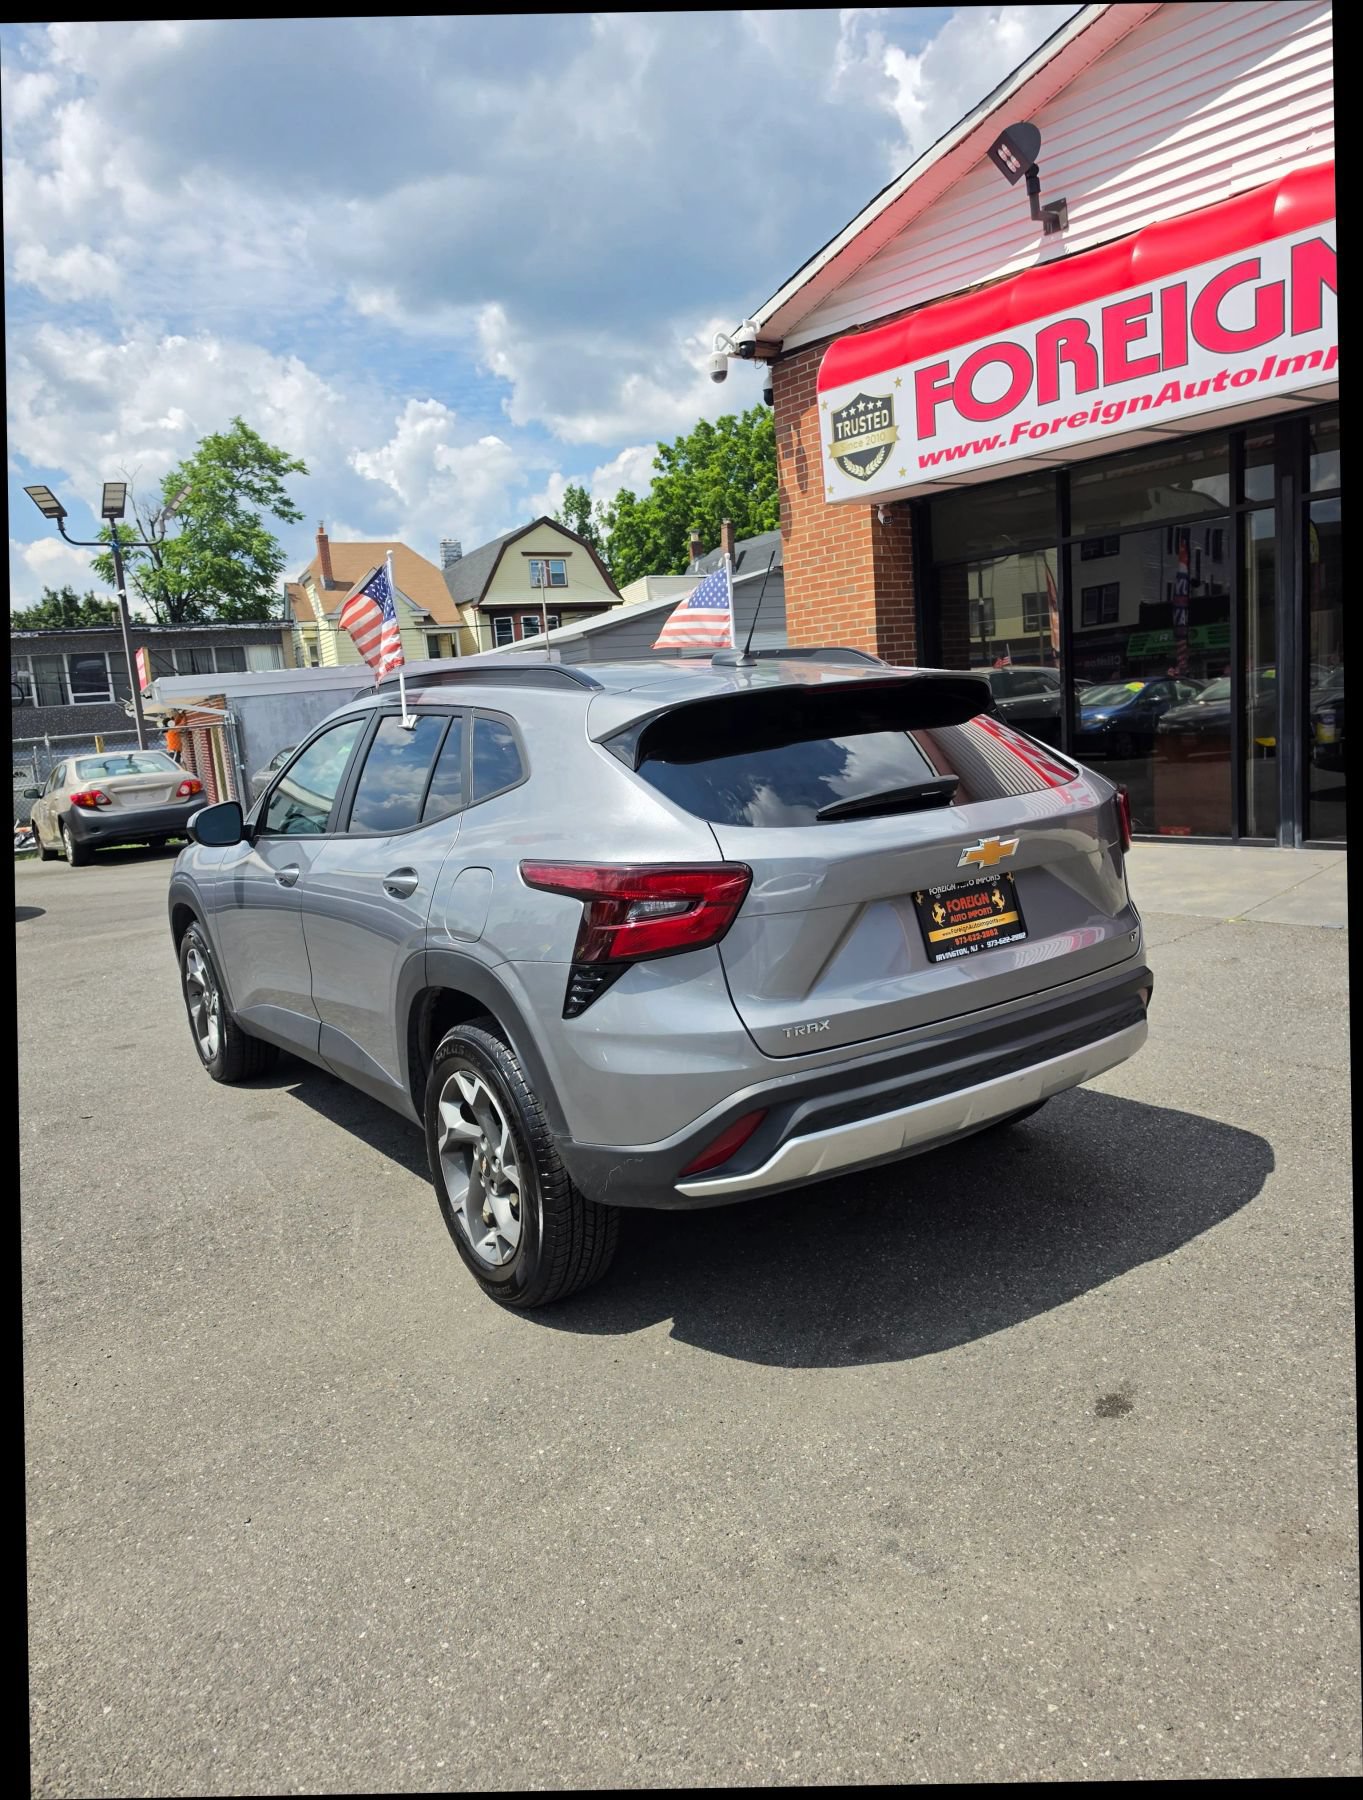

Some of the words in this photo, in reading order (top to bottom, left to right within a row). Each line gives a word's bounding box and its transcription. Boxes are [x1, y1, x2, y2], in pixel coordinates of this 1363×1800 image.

[914, 237, 1338, 440] FOREIGN
[836, 409, 889, 439] TRUSTED
[865, 431, 886, 446] 2010
[946, 892, 989, 912] FOREIGN
[951, 912, 967, 923] AUTO
[967, 906, 992, 919] IMPORTS
[970, 944, 978, 953] NJ
[782, 1019, 831, 1038] TRAX
